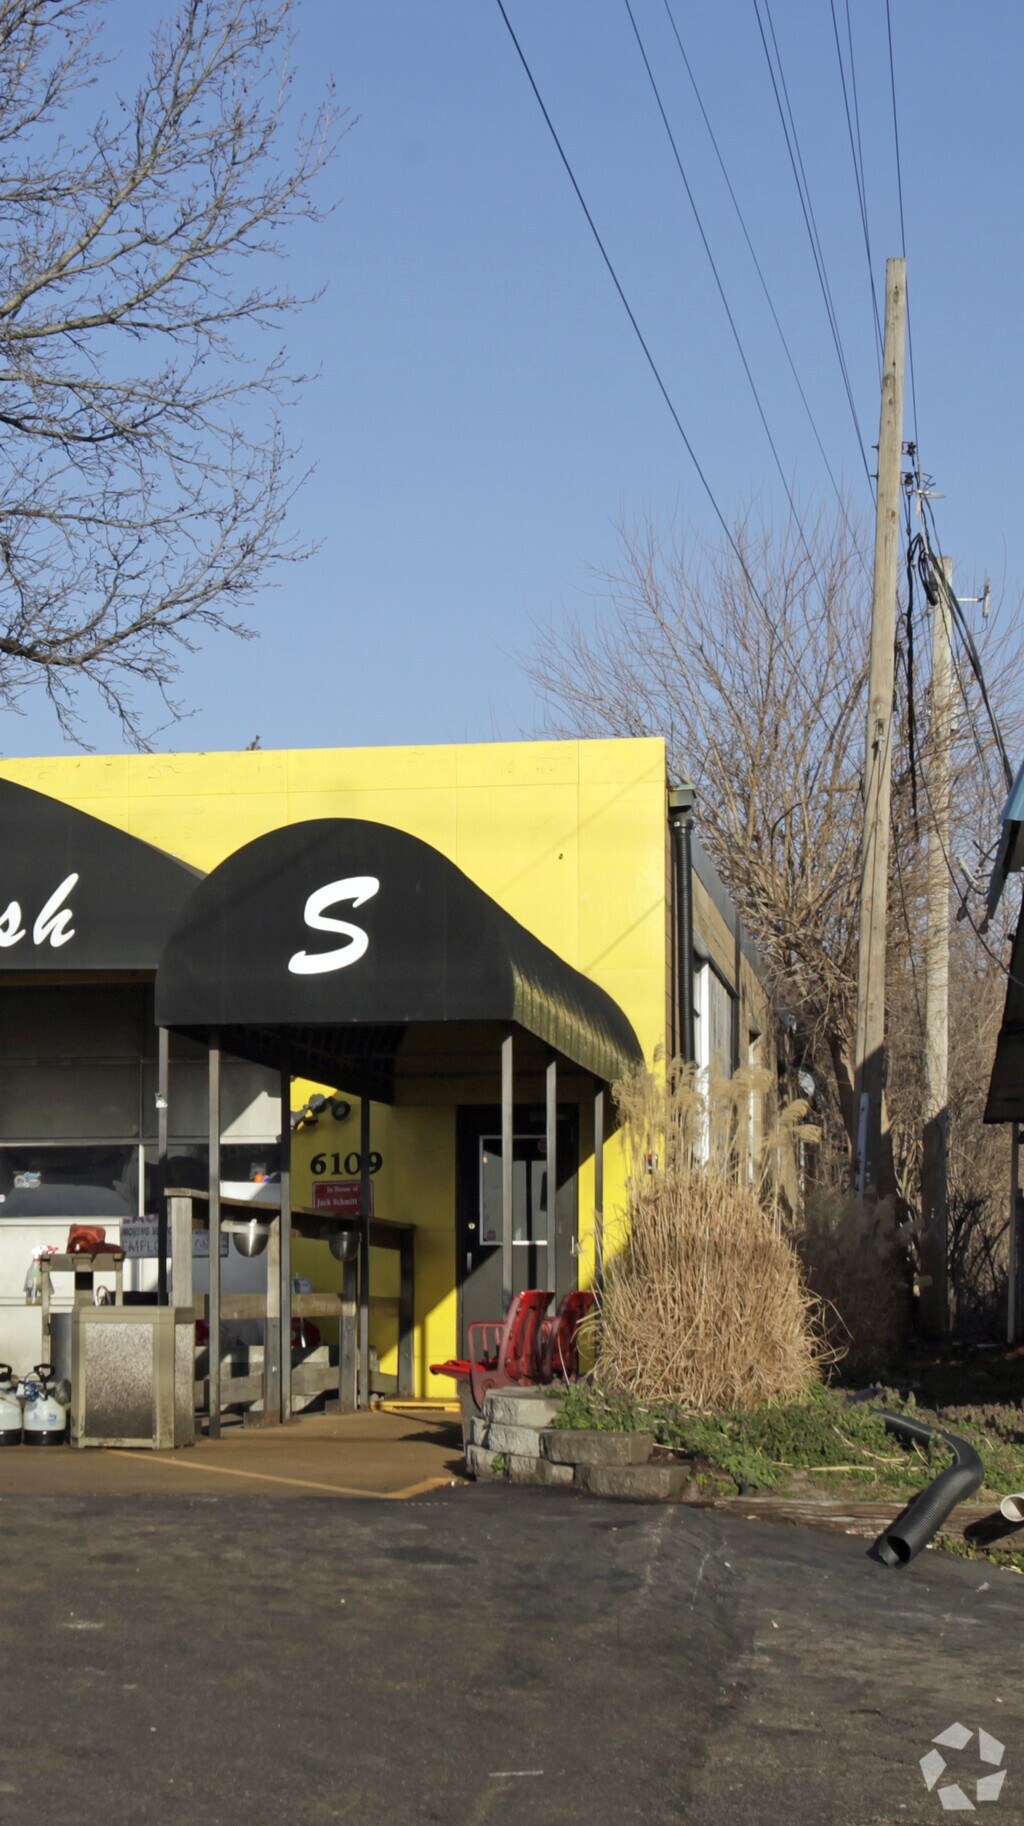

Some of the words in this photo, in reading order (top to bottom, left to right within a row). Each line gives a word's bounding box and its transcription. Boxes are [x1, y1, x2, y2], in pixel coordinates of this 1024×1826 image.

[288, 876, 380, 974] S
[310, 1152, 383, 1175] 6109
[317, 1198, 331, 1208] Jack
[333, 1197, 358, 1206] Schmitt
